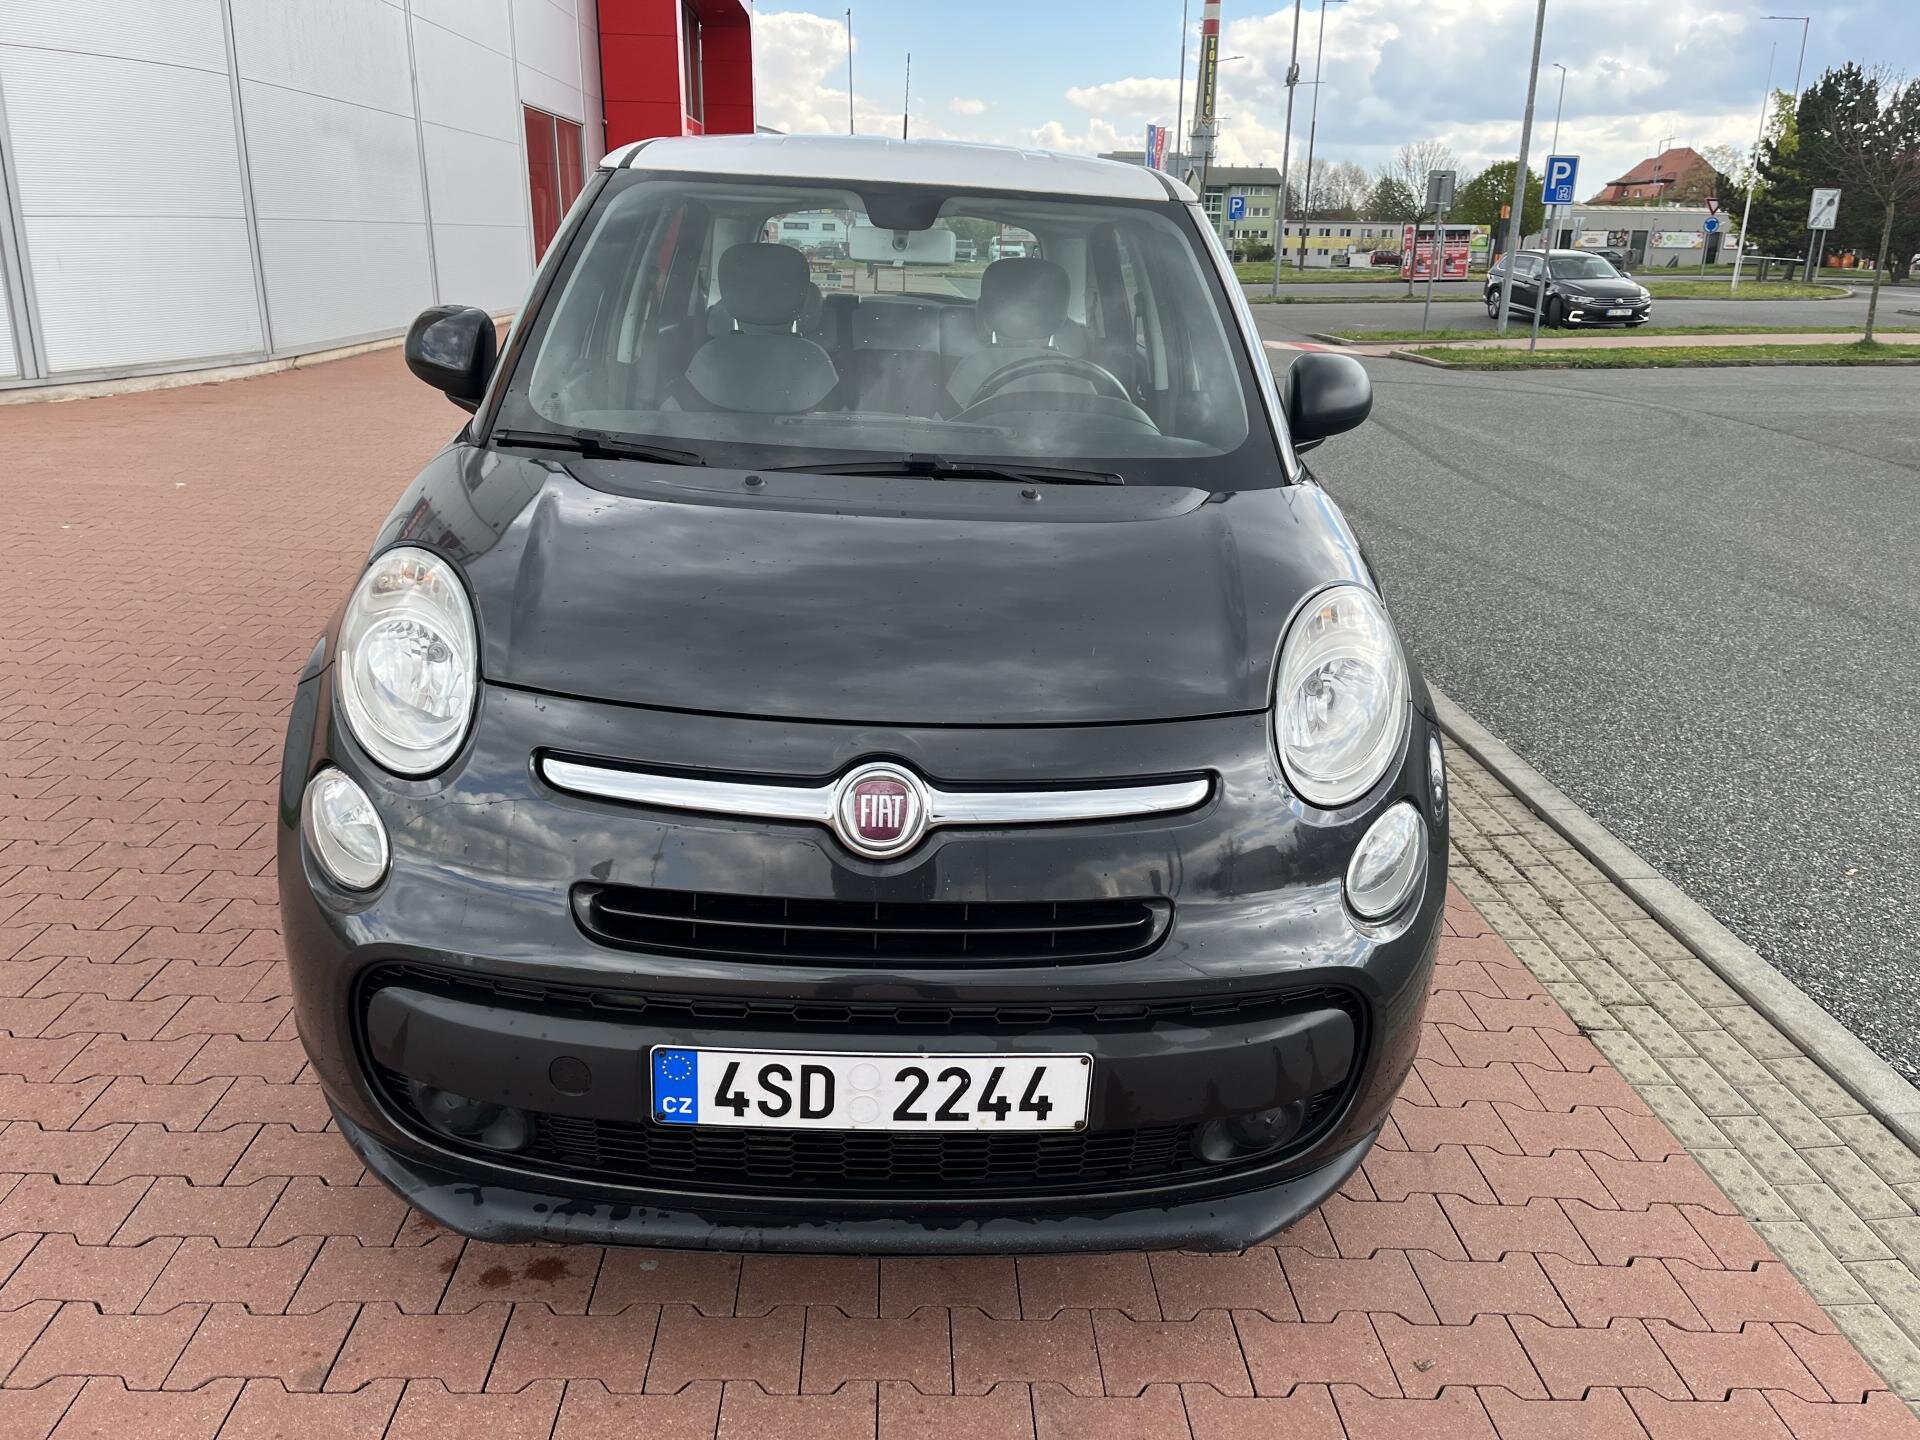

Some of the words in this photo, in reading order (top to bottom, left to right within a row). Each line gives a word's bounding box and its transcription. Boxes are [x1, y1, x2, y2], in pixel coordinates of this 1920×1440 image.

[1550, 162, 1571, 189] P
[1232, 199, 1242, 213] P
[860, 794, 903, 827] FIAT
[714, 1061, 836, 1119] 4SD
[892, 1066, 1053, 1121] 2244
[662, 1096, 692, 1114] CZ
